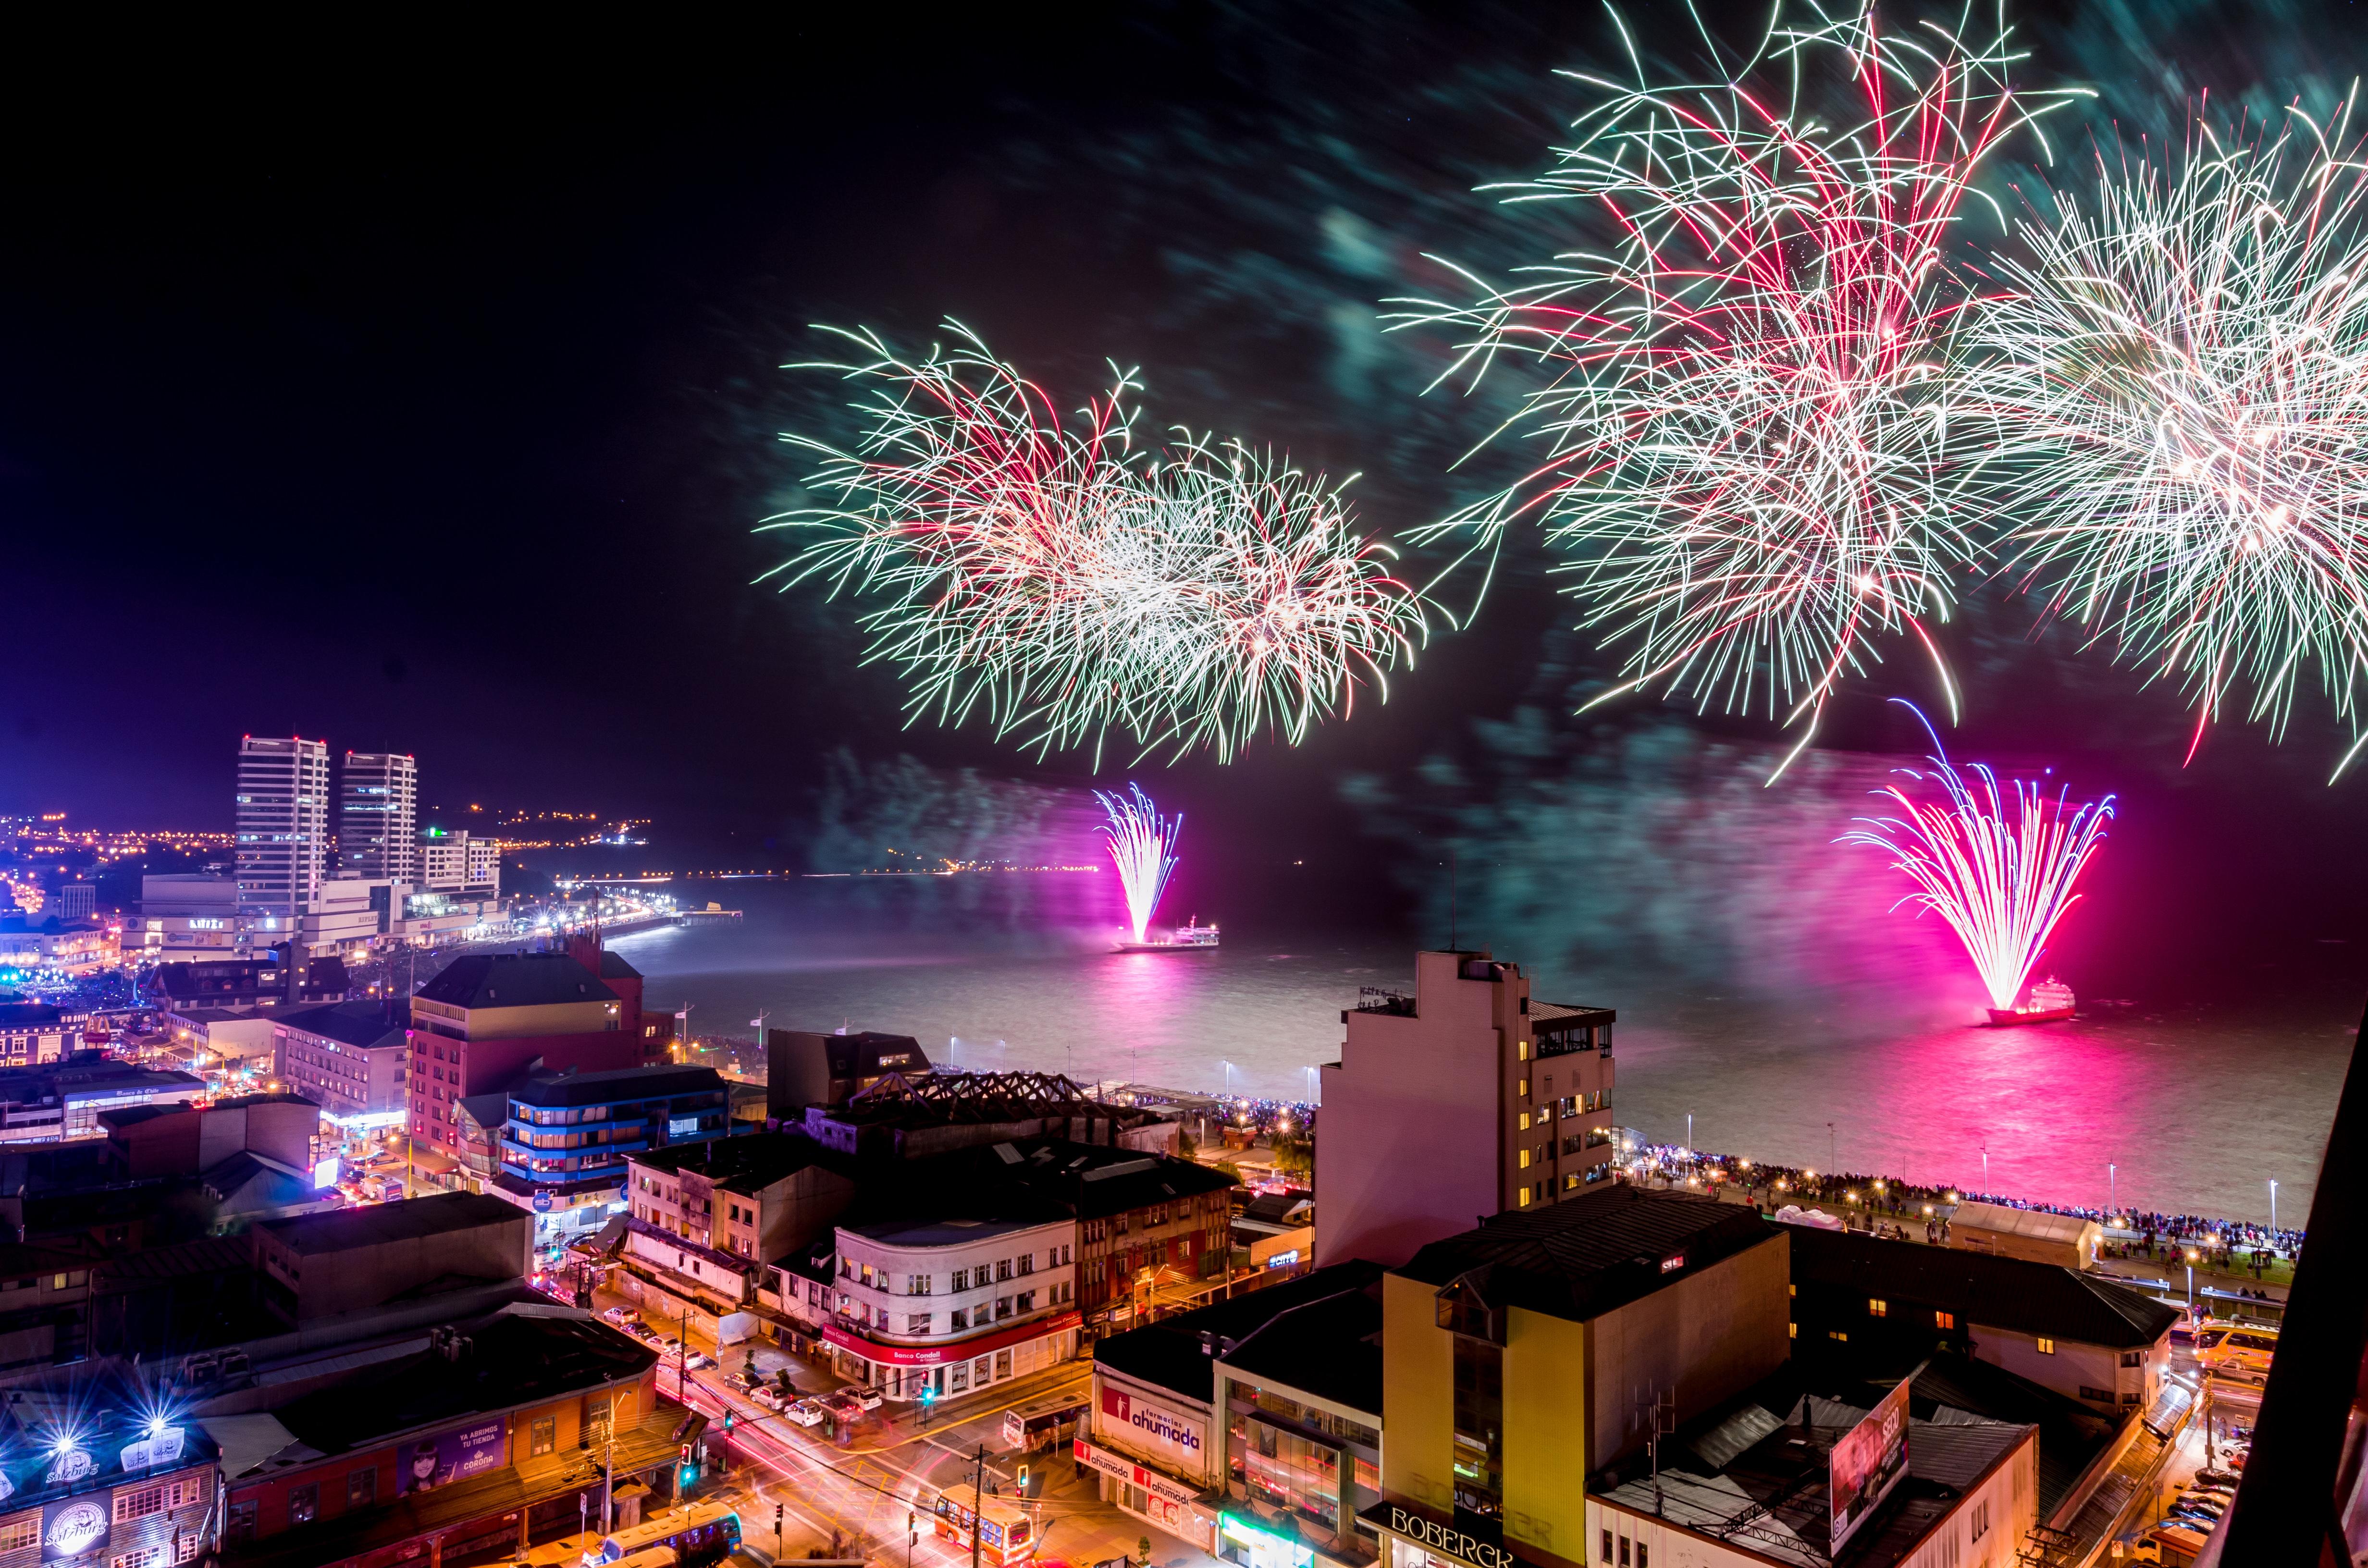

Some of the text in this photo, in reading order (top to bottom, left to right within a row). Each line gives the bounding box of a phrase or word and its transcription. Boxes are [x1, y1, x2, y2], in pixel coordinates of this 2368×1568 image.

[915, 1351, 940, 1359] Condell
[1146, 1408, 1182, 1428] farmacias
[1882, 1407, 1899, 1446] SECO
[470, 1425, 498, 1439] ABRIMOS
[473, 1433, 495, 1446] TIENDA
[1132, 1410, 1200, 1450] ahumada
[464, 1455, 493, 1470] CORONA
[1091, 1455, 1128, 1479] ahumada
[1098, 1455, 1118, 1467] farmacias
[46, 1463, 99, 1483] Salzburg
[1159, 1482, 1180, 1495] farmacias
[44, 1521, 109, 1546] Salzburg
[1392, 1507, 1513, 1568] BOBERCK
